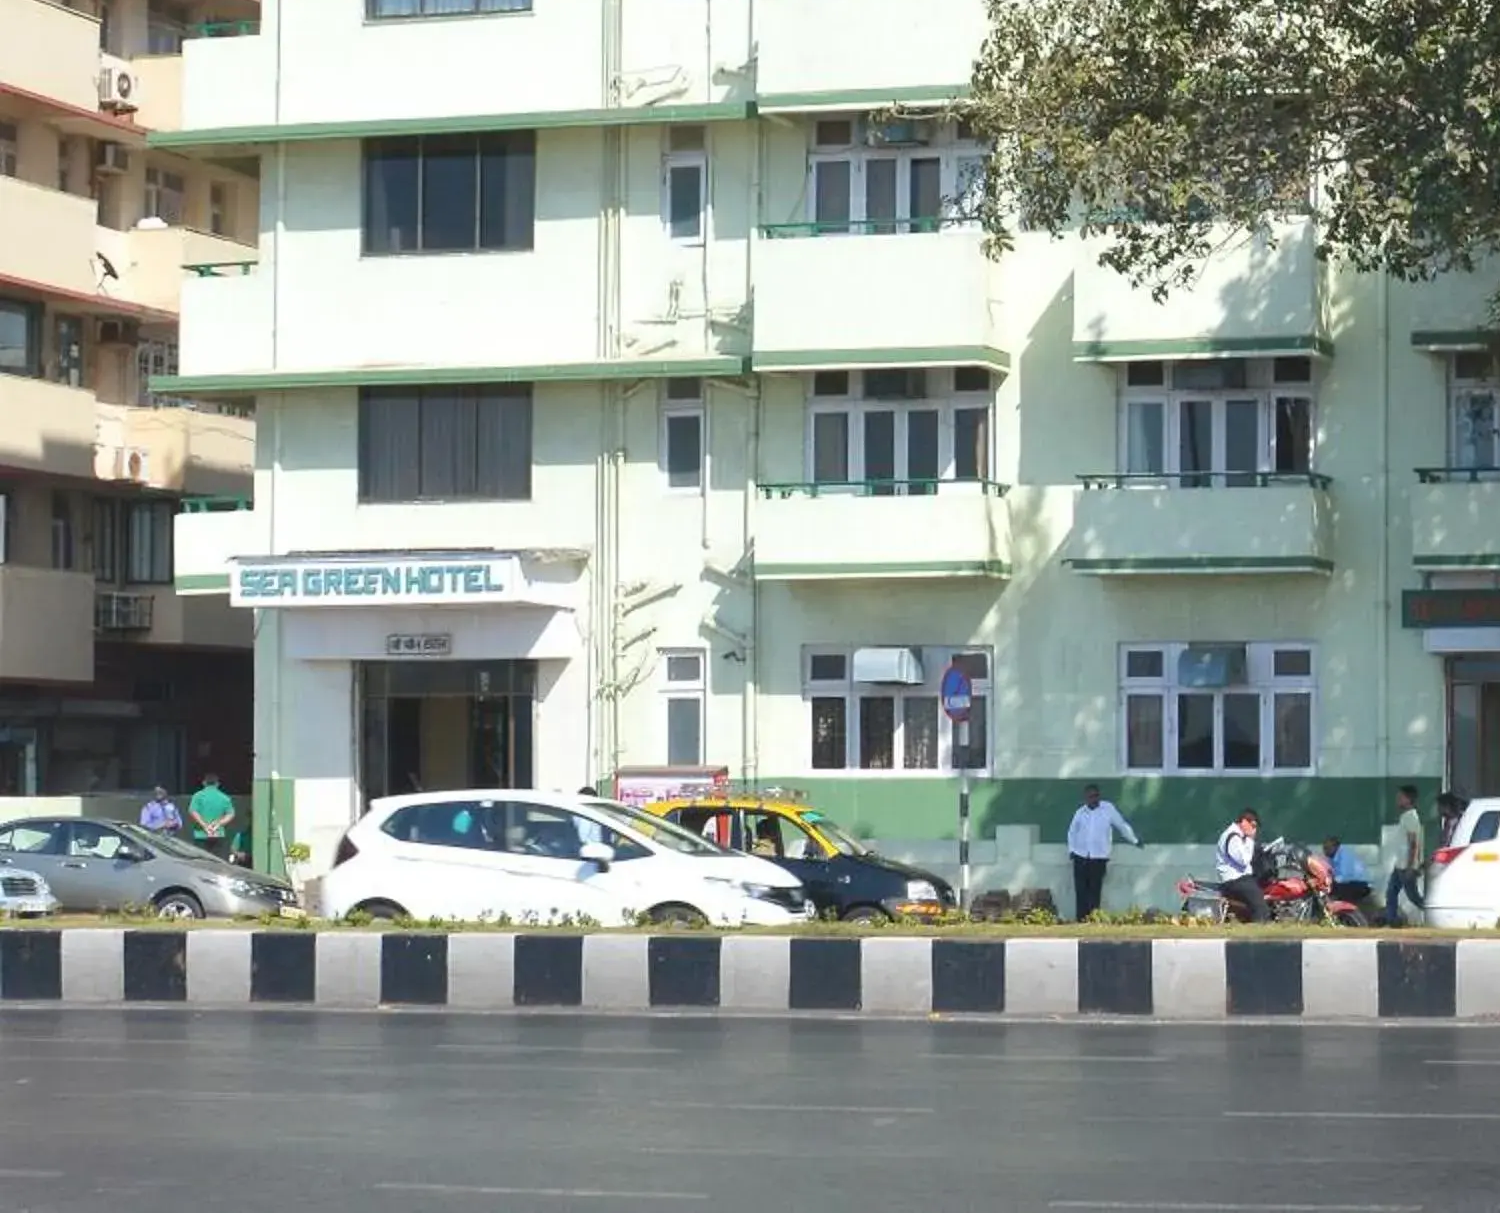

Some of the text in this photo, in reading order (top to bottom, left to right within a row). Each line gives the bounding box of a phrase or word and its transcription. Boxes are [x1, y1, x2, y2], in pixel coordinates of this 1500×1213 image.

[240, 564, 504, 597] SEA GREEN HOTEL
